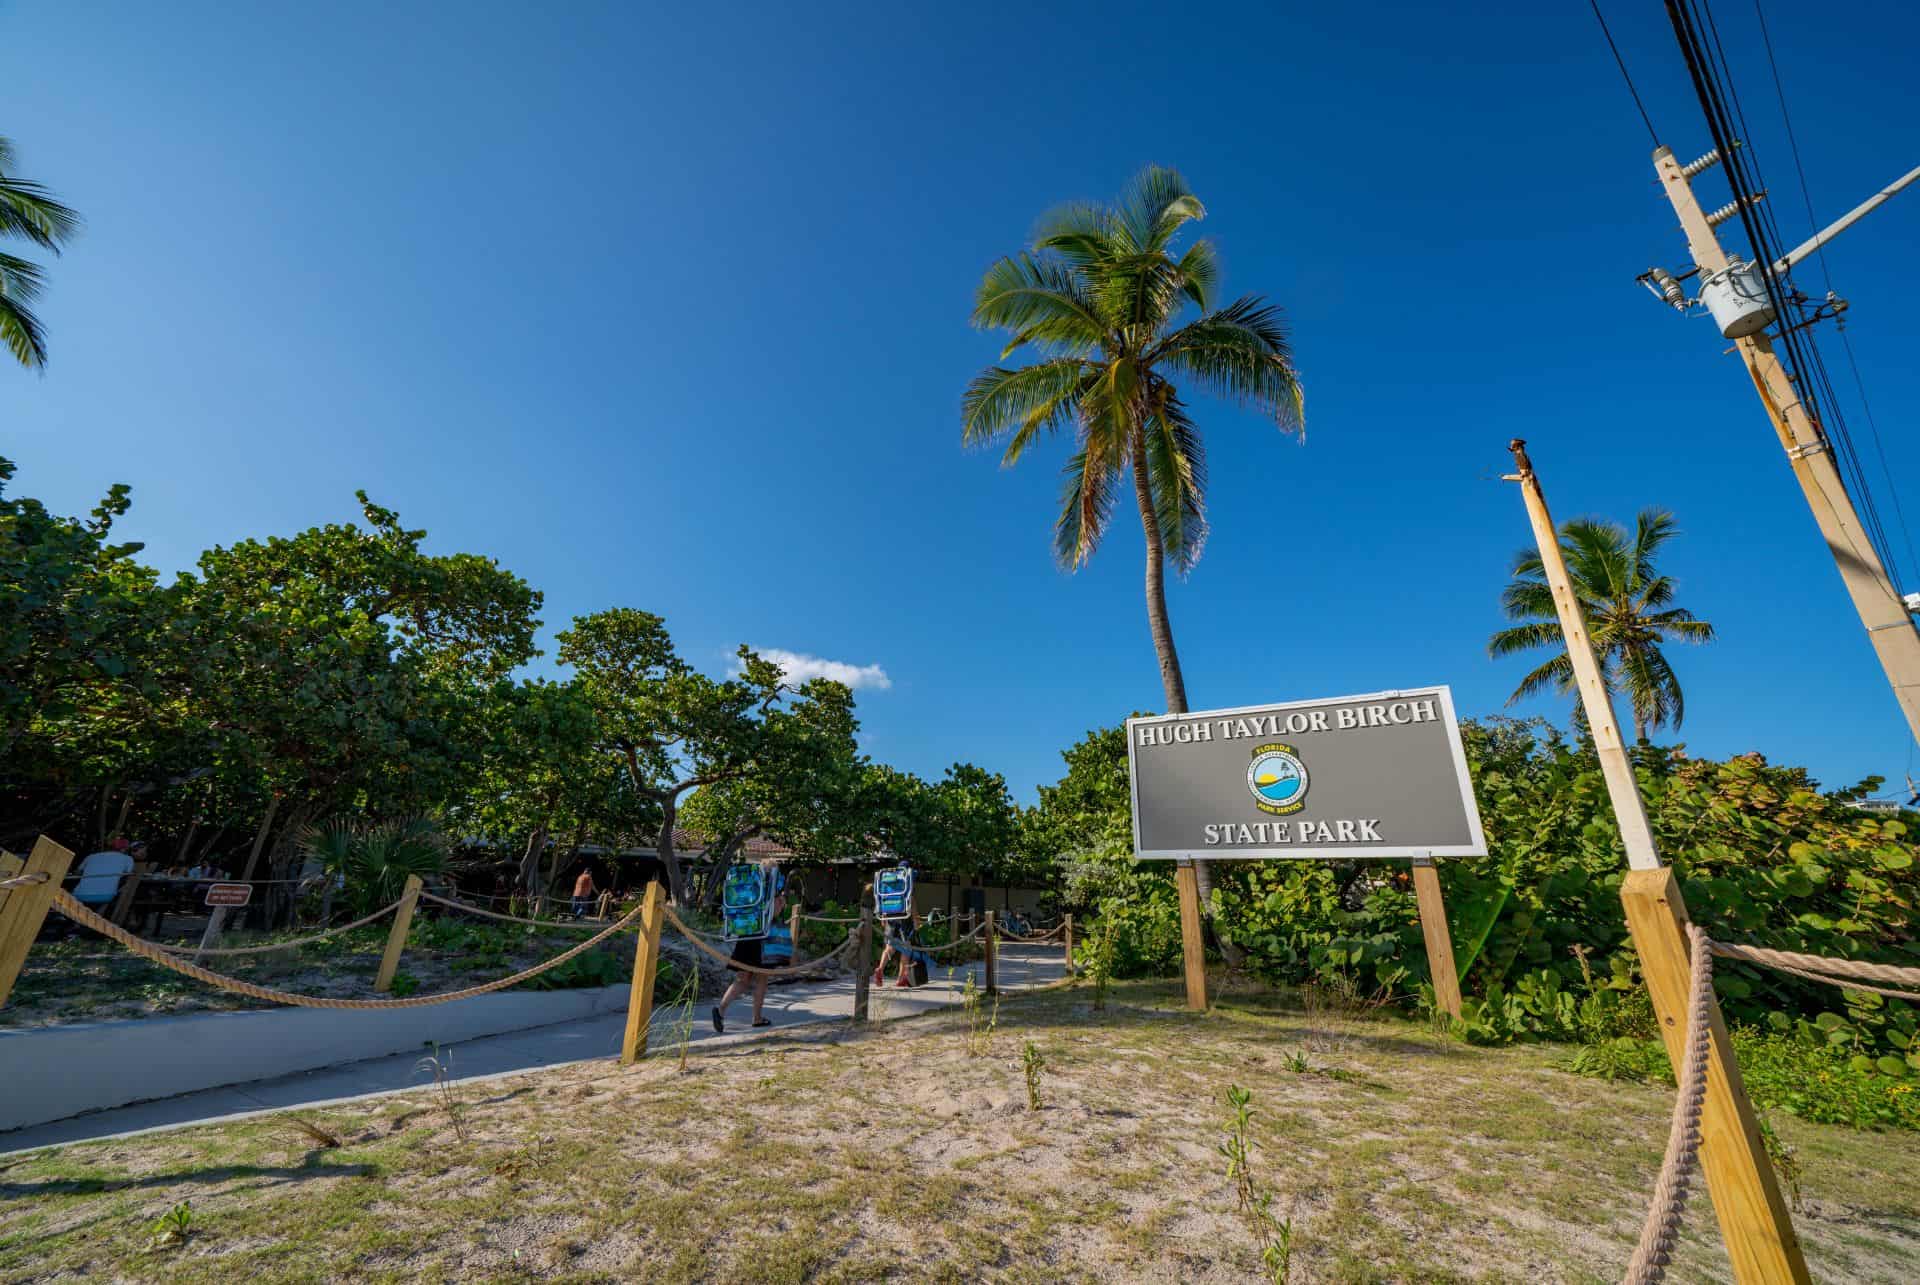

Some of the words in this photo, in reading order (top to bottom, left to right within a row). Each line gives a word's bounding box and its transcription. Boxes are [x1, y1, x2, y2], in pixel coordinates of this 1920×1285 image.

[1139, 721, 1213, 746] HUGH
[1218, 710, 1330, 739] TAYLOR
[1336, 700, 1438, 729] BIRCH
[1255, 744, 1291, 754] FLORIDA
[1257, 802, 1275, 813] PARK
[1276, 801, 1303, 814] SERVICE
[1204, 822, 1291, 844] STATE
[1298, 819, 1383, 842] PARK
